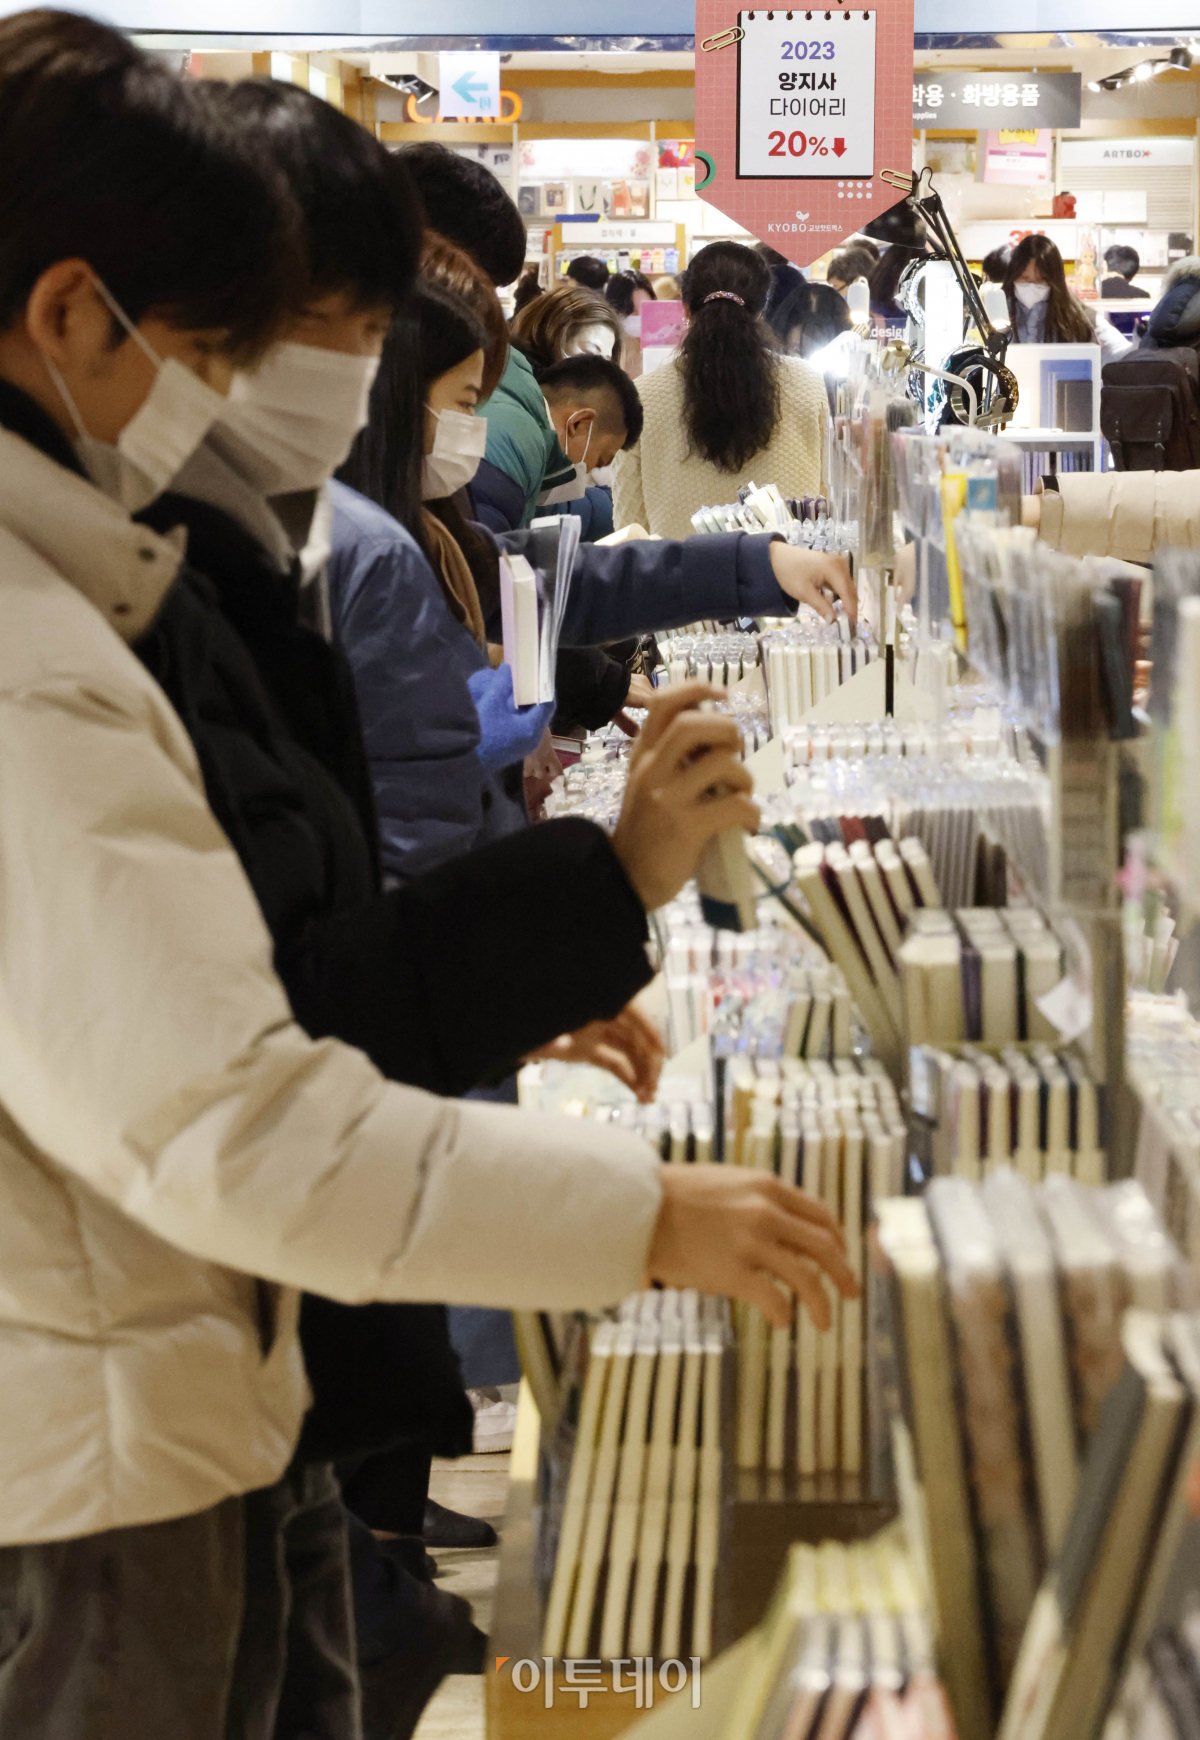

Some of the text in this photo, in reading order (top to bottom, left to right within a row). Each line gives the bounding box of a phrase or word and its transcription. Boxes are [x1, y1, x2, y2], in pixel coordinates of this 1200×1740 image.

[780, 41, 836, 60] 2023
[778, 72, 837, 91] 양지사
[961, 83, 1041, 108] 화방용품
[407, 90, 523, 124] CD
[770, 98, 846, 117] 다이어리
[912, 112, 938, 120] upplies
[767, 130, 829, 157] 20%
[1103, 150, 1151, 158] ARTBOX
[768, 223, 807, 232] KYOBO
